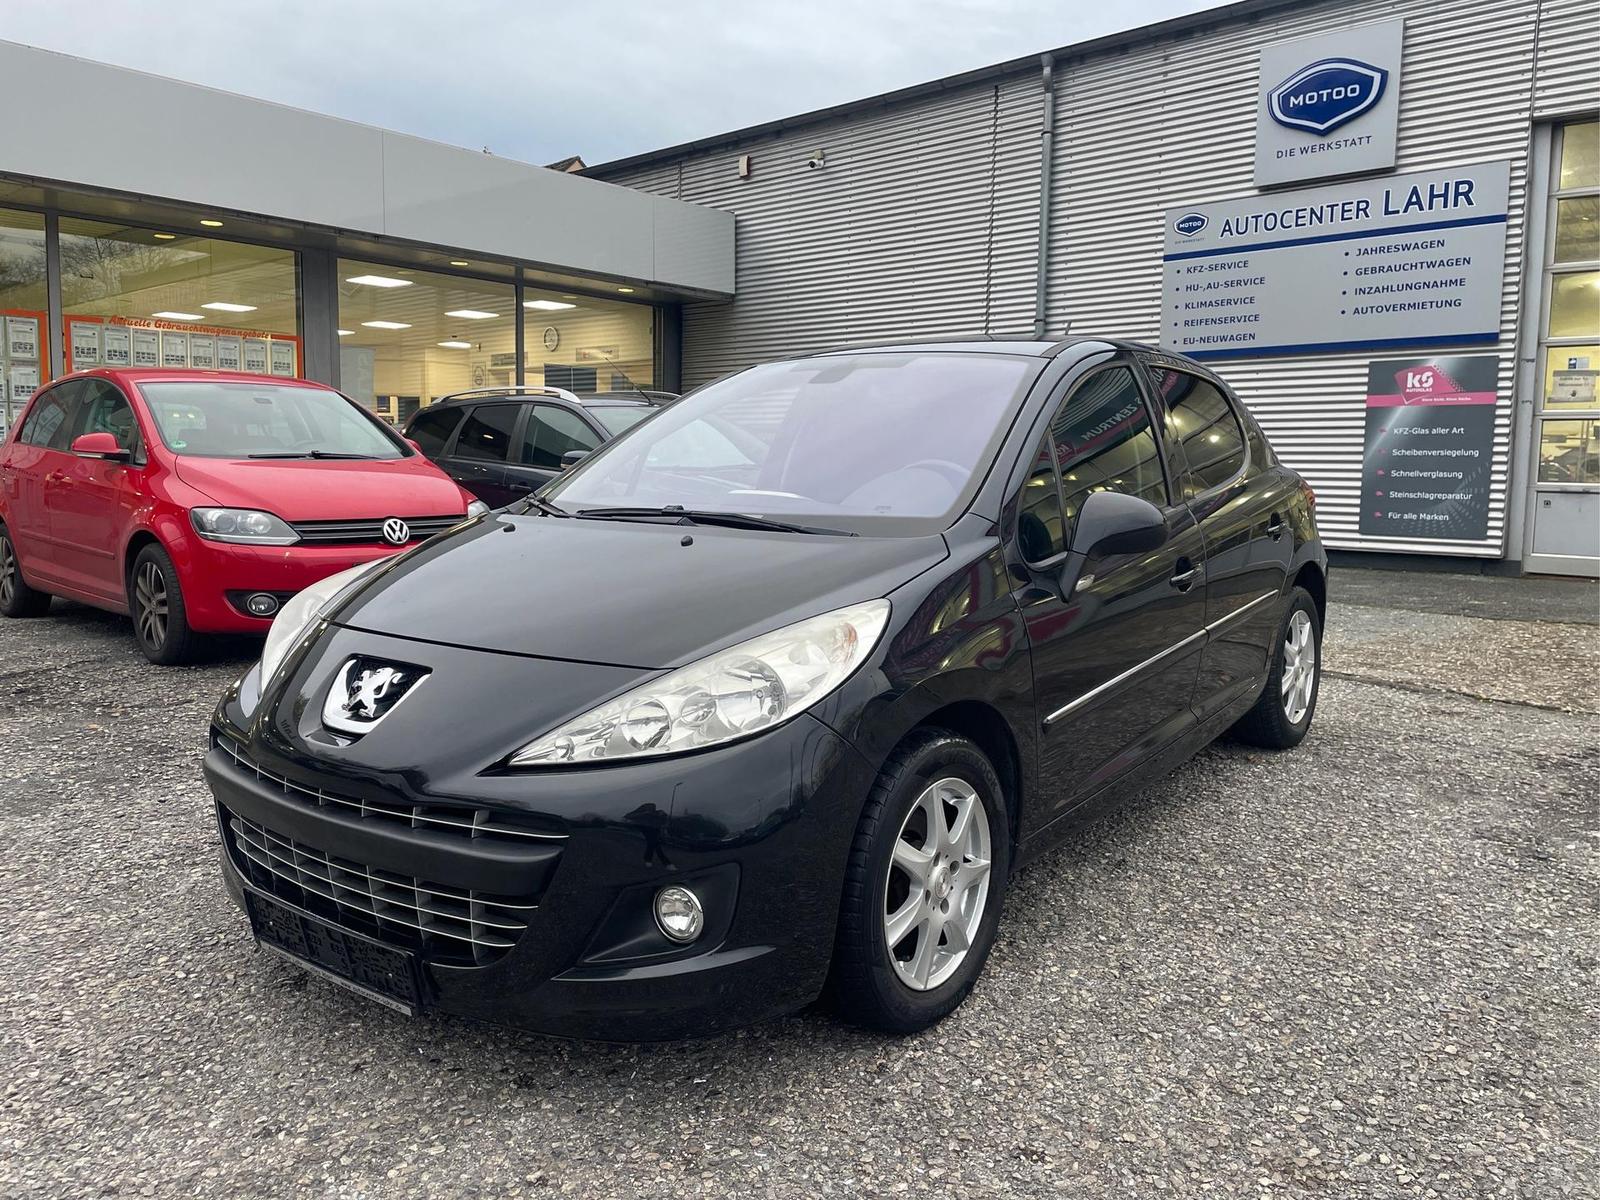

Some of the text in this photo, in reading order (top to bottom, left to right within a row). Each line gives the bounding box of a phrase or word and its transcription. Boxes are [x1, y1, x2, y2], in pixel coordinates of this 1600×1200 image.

[1289, 84, 1360, 108] MOTOO
[1276, 135, 1373, 159] DIE WERKSTATT
[1219, 179, 1475, 238] AUTOCENTER LAHR
[1179, 220, 1202, 229] MOTOO
[1355, 239, 1445, 257] JAHRESWAGEN
[1186, 260, 1249, 274] KFZ-SERVICE
[1355, 257, 1472, 276] GEBRAUCHTWAGEN
[1354, 278, 1467, 296] INZAHLUNGNAHME
[1184, 296, 1256, 310] KLIMASERVICE
[1352, 299, 1463, 315] AUTOVERMIETUNG
[109, 315, 270, 340] Aktuelle Gebrauchtwagenangebote
[1183, 314, 1260, 328] REIFENSERVICE
[1183, 333, 1256, 345] EU-NEUWAGEN
[1392, 448, 1480, 458] Scheibenversiegelung
[1391, 469, 1463, 479] Schnellverglasung
[1389, 491, 1473, 500] Steinschlagreparatur
[1388, 511, 1449, 521] Für alle Marken
